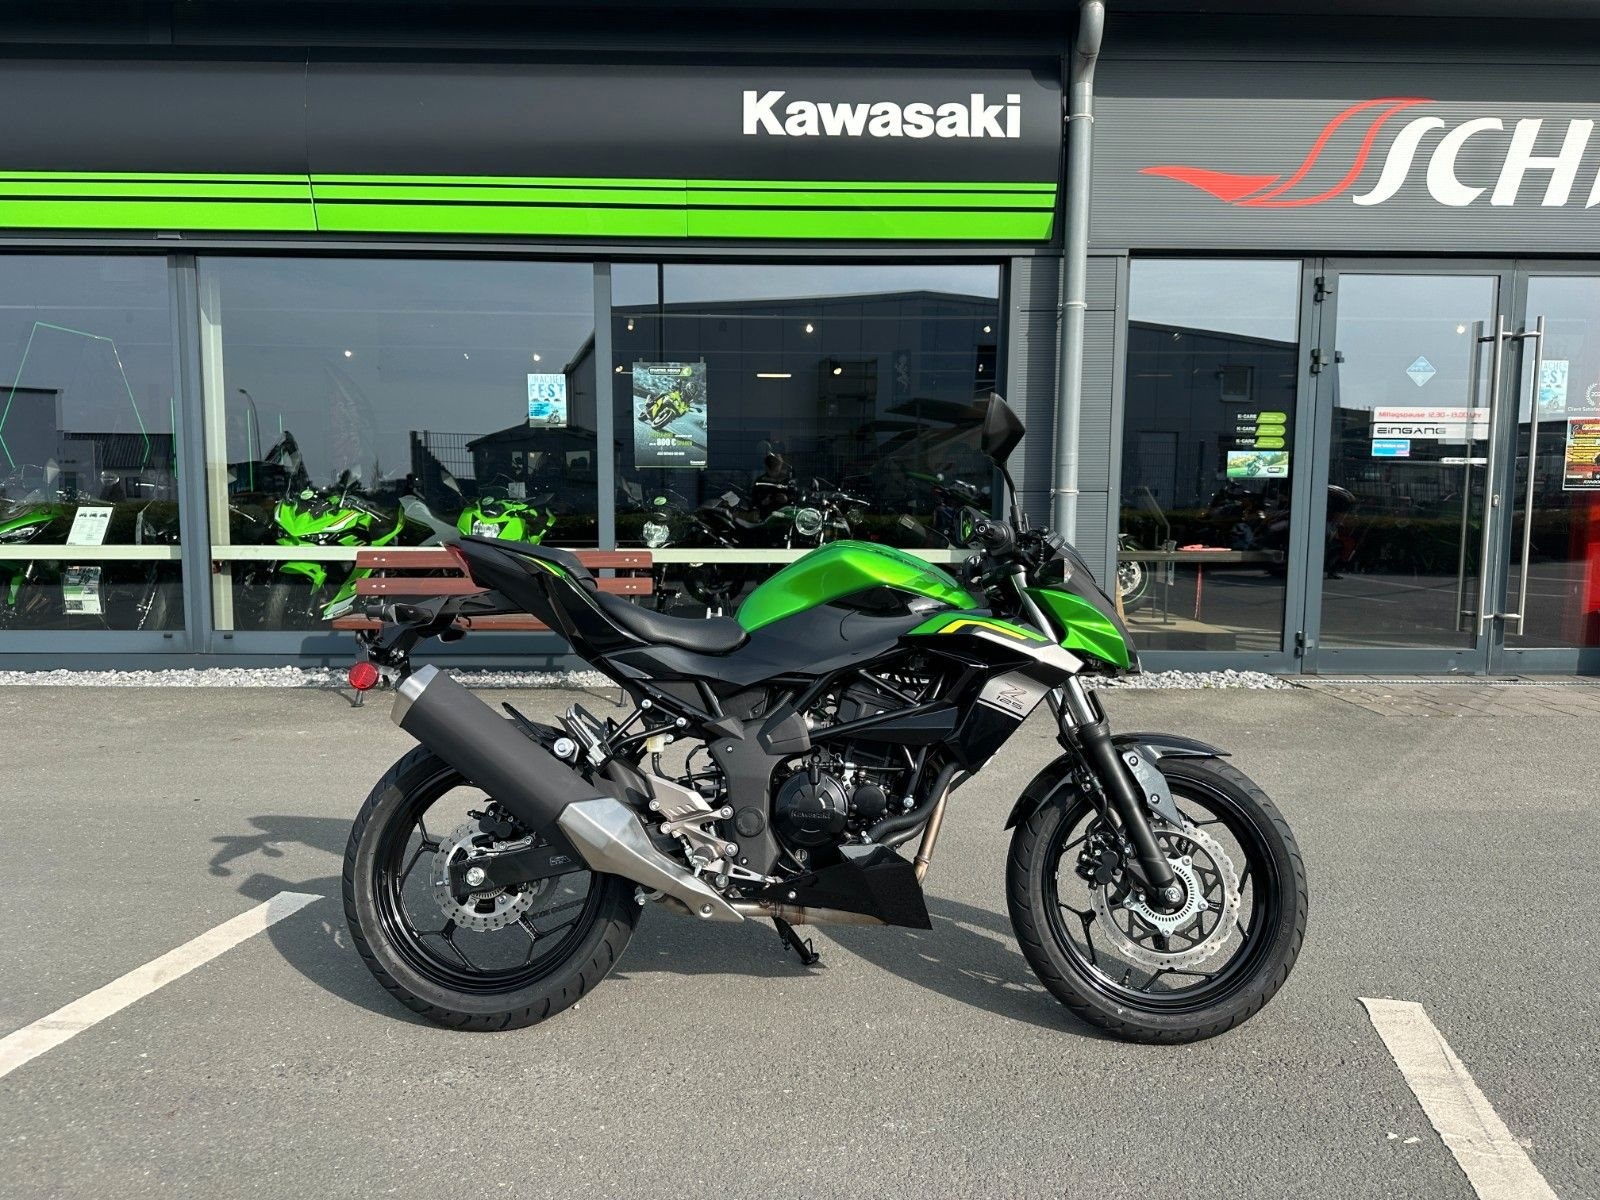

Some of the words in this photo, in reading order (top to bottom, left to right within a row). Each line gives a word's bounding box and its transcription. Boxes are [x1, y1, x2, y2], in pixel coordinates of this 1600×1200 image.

[743, 90, 1021, 138] Kawasaki
[1353, 116, 1600, 208] SCH
[529, 383, 565, 398] FEST
[1378, 410, 1426, 419] Mittagspause
[656, 438, 671, 446] 800
[996, 695, 1022, 710] 125
